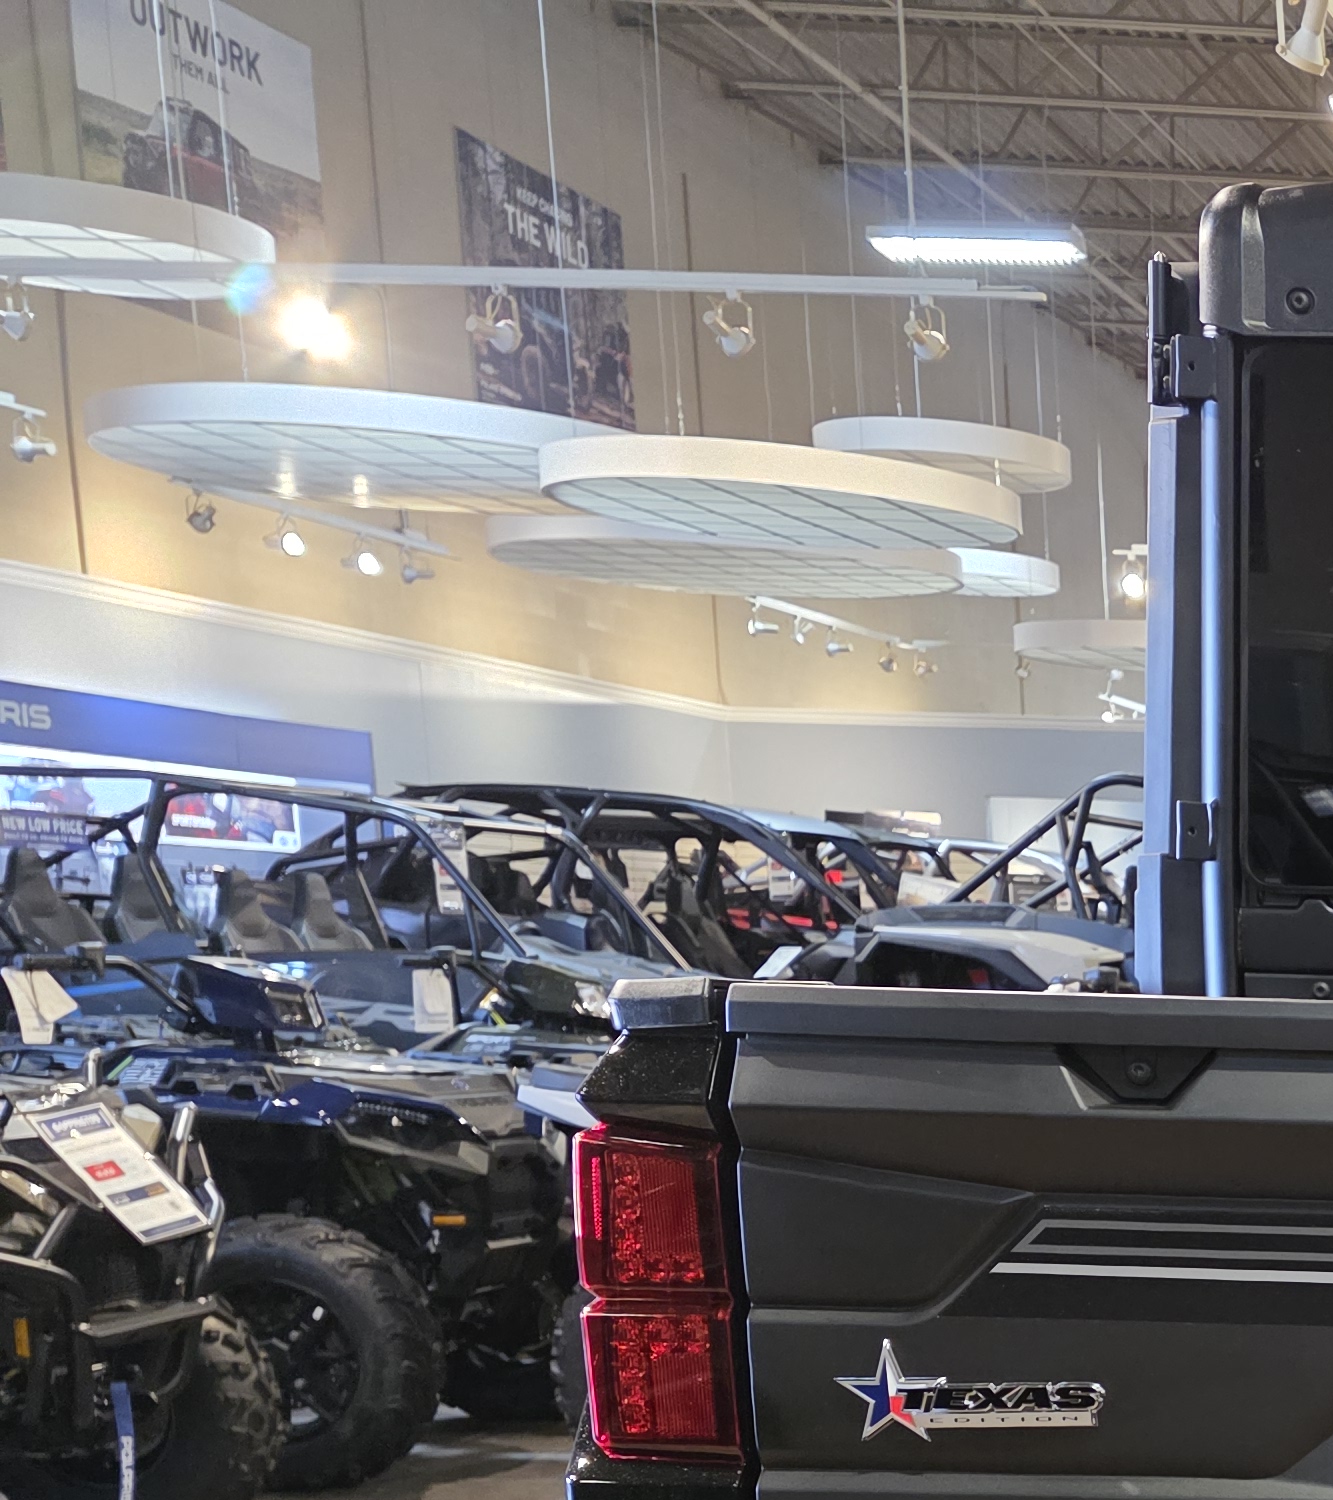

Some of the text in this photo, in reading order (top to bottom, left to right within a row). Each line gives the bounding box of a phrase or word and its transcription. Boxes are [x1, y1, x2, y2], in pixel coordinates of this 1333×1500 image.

[503, 201, 590, 269] THE WILD
[2, 815, 84, 835] NEW LOW PRICE
[896, 1382, 1103, 1412] TEXAS
[929, 1415, 1079, 1424] EDITION
